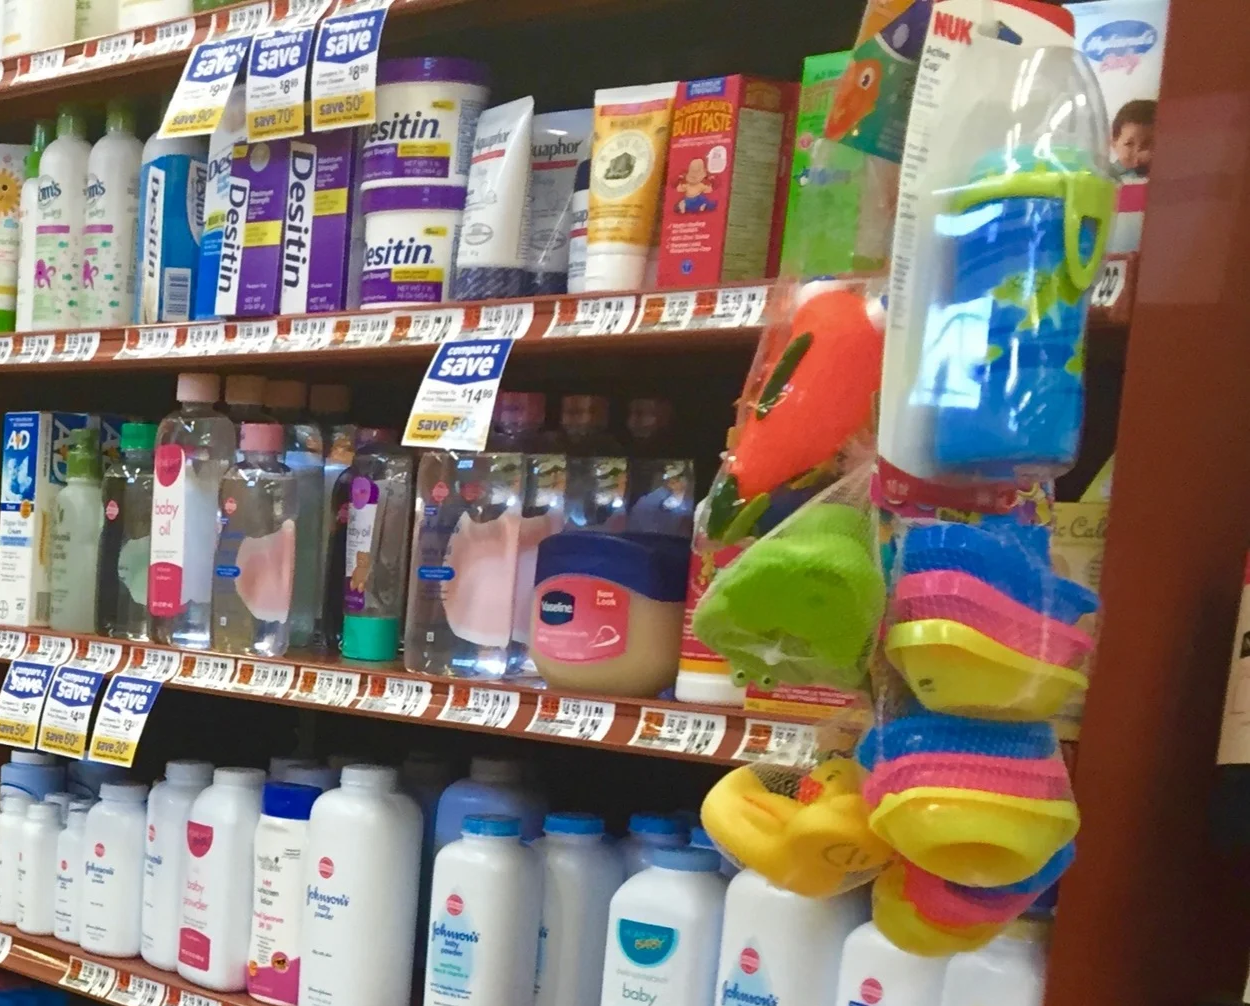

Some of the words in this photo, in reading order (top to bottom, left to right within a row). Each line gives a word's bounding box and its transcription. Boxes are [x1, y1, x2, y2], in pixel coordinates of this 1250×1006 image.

[933, 11, 972, 46] NUK
[324, 29, 371, 57] save
[257, 45, 301, 71] save
[319, 101, 344, 117] save
[345, 94, 365, 111] 50¢
[173, 113, 196, 125] save
[254, 114, 276, 129] save
[369, 111, 440, 142] esitin
[673, 115, 700, 137] BUTT
[701, 113, 732, 133] PASTE
[284, 150, 314, 289] Desitin
[218, 184, 247, 293] Desitin
[366, 237, 433, 266] esitin
[447, 344, 491, 356] compare
[492, 344, 500, 354] &
[438, 357, 494, 377] save
[417, 419, 448, 431] save
[155, 501, 179, 523] baby
[158, 519, 171, 537] oil
[596, 590, 614, 600] New
[596, 597, 616, 607] Look
[541, 599, 574, 615] Vaseline
[57, 682, 91, 702] save
[117, 680, 145, 693] compare
[112, 690, 147, 711] save
[46, 731, 63, 743] save
[97, 741, 114, 753] save
[187, 879, 204, 894] baby
[306, 884, 349, 906] Johnson's
[432, 921, 480, 945] Johnson's
[440, 946, 463, 957] powder
[444, 938, 459, 950] baby
[622, 983, 657, 1006] baby
